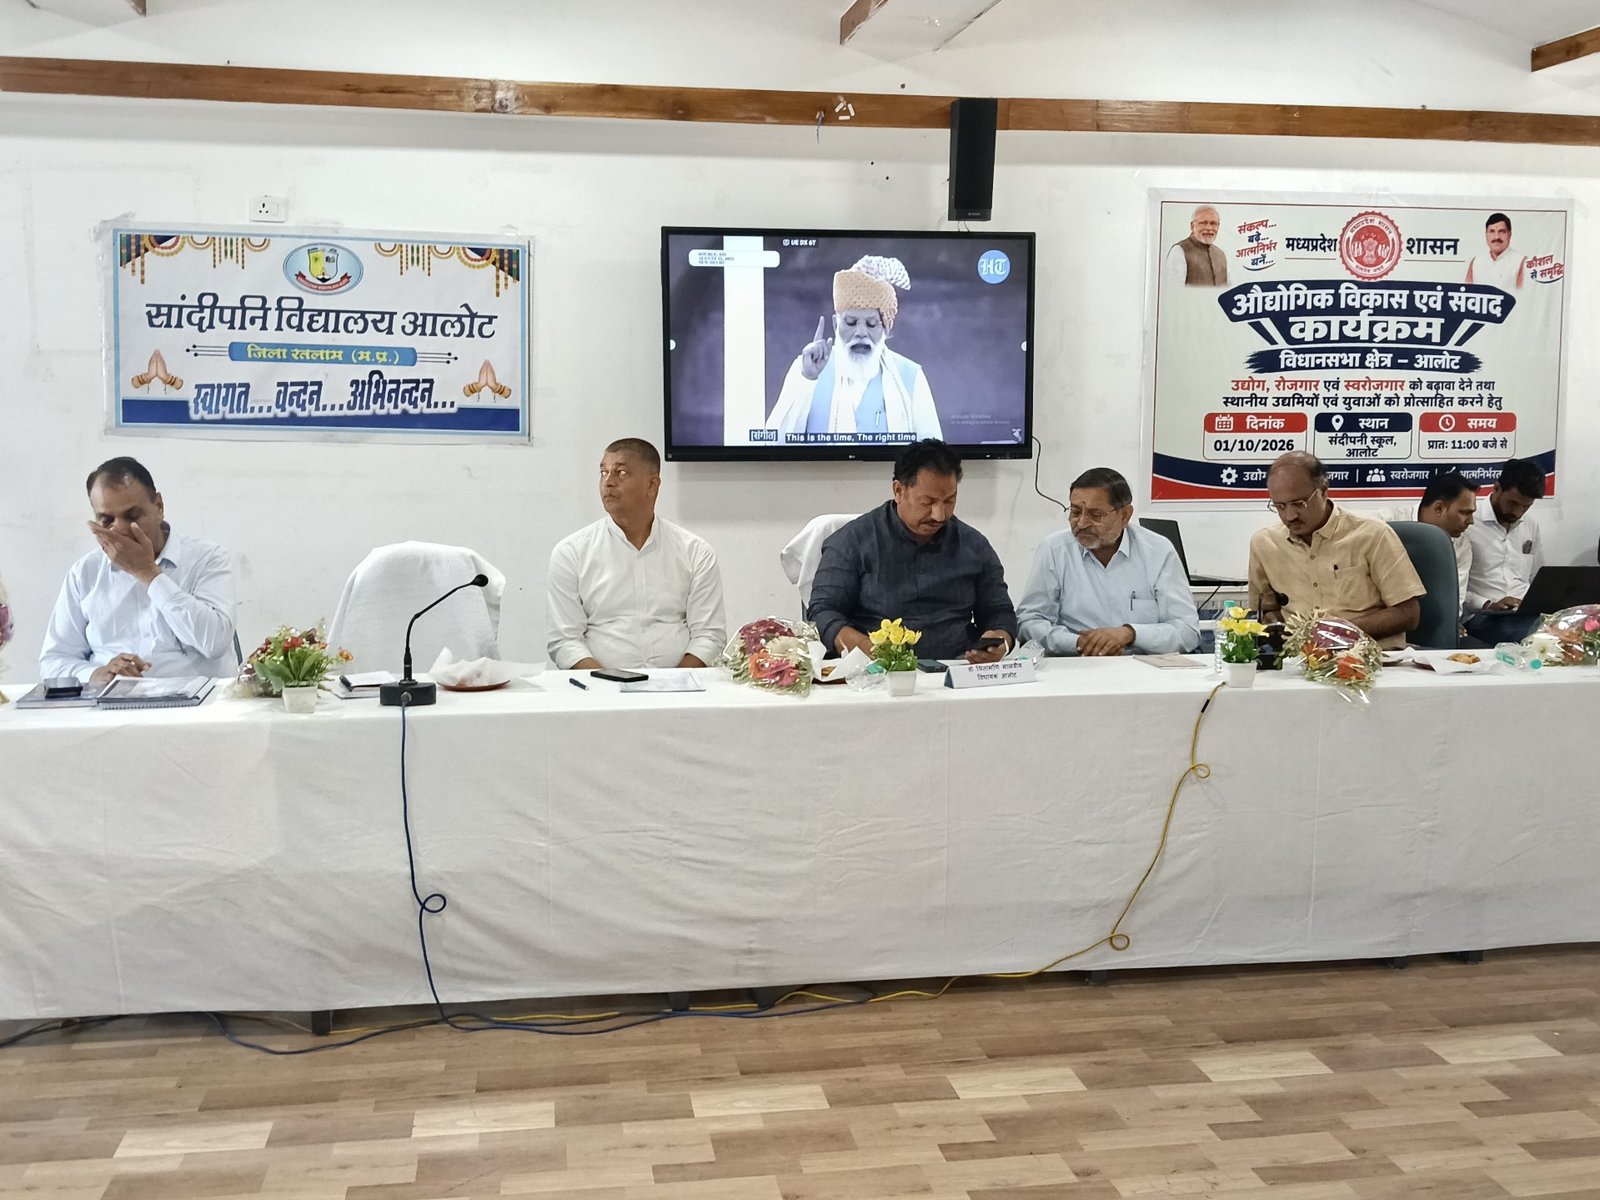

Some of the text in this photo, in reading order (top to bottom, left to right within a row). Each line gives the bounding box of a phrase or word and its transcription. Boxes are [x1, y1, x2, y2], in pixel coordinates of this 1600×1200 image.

[1237, 219, 1277, 234] संकल्प...
[1235, 240, 1278, 258] आत्मनिर्भर
[1285, 233, 1460, 255] मध्यप्रदेश शासन
[980, 258, 1007, 275] HT
[1526, 254, 1554, 269] कौशल
[1530, 269, 1538, 280] से
[1231, 282, 1504, 318] औद्योगिक विकास एवं संवाद
[145, 292, 498, 338] सांदीपनि विद्यालय आलोट
[1288, 308, 1445, 343] कार्यक्रम
[247, 344, 400, 364] जिला रतलाम (म.प्र.)
[1279, 349, 1361, 369] विधानसभा
[1364, 348, 1393, 369] क्षेत्र
[1413, 350, 1461, 370] आलोट
[1231, 376, 1495, 394] उद्योग, रोजगार एवं स्वरोजगार को बढ़ावा देने तथा
[1223, 393, 1503, 411] स्थानीय उद्यमियों एवं युवाओं को प्रोत्साहित करने हेतु
[1245, 415, 1286, 430] दिनांक
[1358, 418, 1389, 430] स्थान
[1467, 418, 1498, 430] समय
[787, 434, 805, 442] This
[807, 434, 815, 442] is
[817, 434, 831, 442] the
[858, 433, 873, 441] The
[875, 433, 895, 443] right
[897, 433, 917, 441] time
[1328, 433, 1397, 448] संदीपनी स्कूल,
[1428, 437, 1508, 450] प्रातः 11:00 बजे से
[1213, 439, 1295, 453] 01/10/2026
[1346, 447, 1379, 457] आलोट
[1390, 468, 1430, 480] स्वरोजगार
